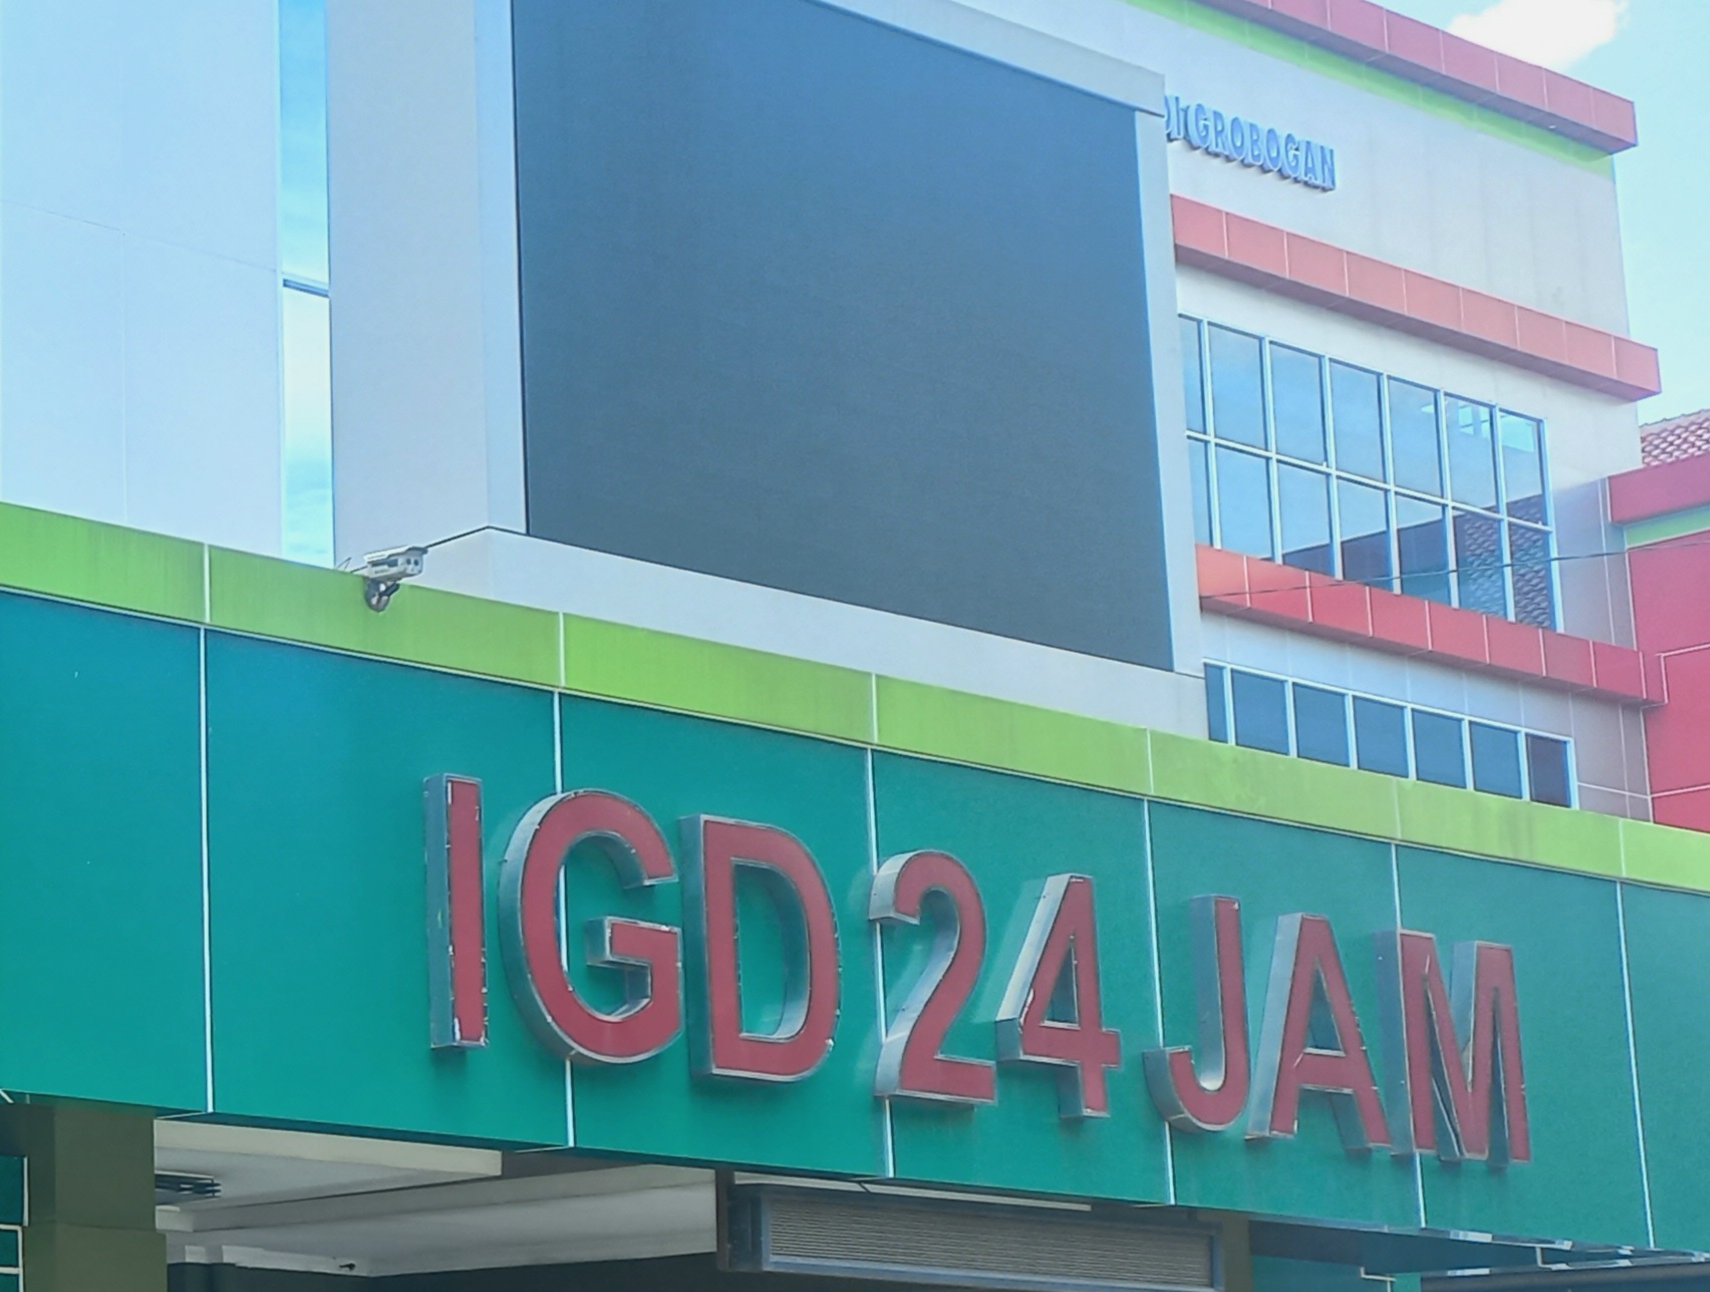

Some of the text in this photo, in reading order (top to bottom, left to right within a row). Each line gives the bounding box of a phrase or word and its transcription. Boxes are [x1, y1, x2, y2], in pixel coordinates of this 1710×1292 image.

[1186, 102, 1336, 190] GROBOGAN
[424, 772, 1532, 1164] IGD 24 JAM
